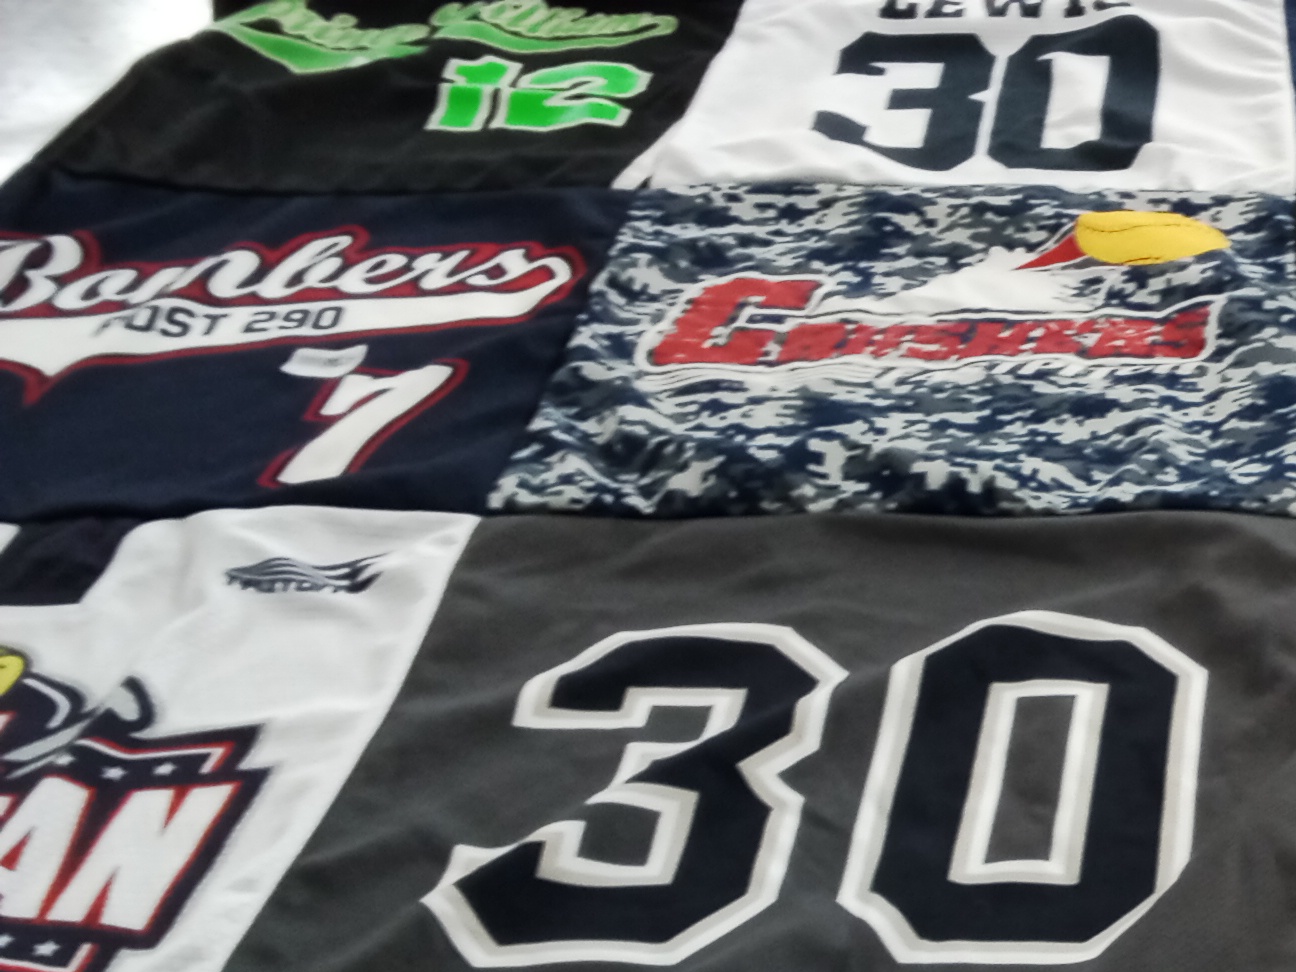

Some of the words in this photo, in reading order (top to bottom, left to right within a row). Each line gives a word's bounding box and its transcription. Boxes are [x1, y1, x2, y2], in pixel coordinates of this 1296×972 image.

[424, 56, 654, 131] 12
[812, 14, 1160, 171] 30
[242, 306, 344, 334] 290
[258, 358, 470, 488] 7
[421, 610, 1209, 967] 30
